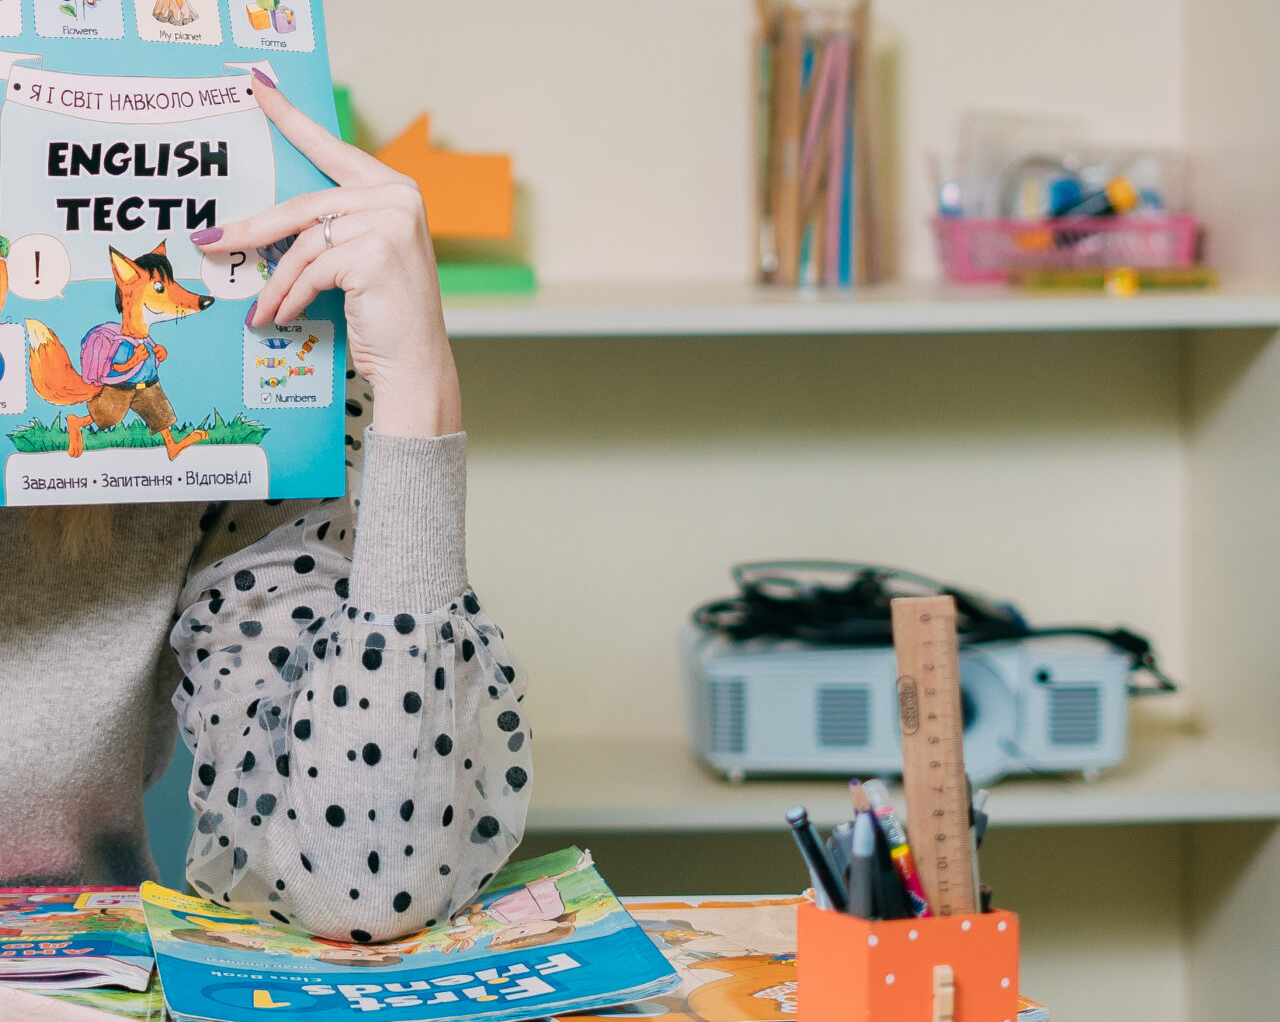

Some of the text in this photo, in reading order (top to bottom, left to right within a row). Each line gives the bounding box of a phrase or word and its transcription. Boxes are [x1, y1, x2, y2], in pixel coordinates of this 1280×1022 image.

[62, 26, 98, 36] Flowers
[159, 30, 202, 41] My planet
[261, 37, 287, 48] Forms
[30, 85, 240, 112] Я І СВІТ НАВКОЛО МЕНЕ
[47, 141, 229, 178] ENGLISH
[56, 196, 217, 232] ТЕСТИ
[34, 250, 41, 285] !
[229, 251, 247, 284] ?
[275, 393, 317, 403] Numbers
[22, 469, 252, 491] Завдання Запитання Відповіді
[2, 942, 73, 950] ДО
[210, 971, 263, 980] Book
[301, 954, 582, 998] Friends
[252, 990, 292, 1009] 1
[346, 978, 556, 1012] First
